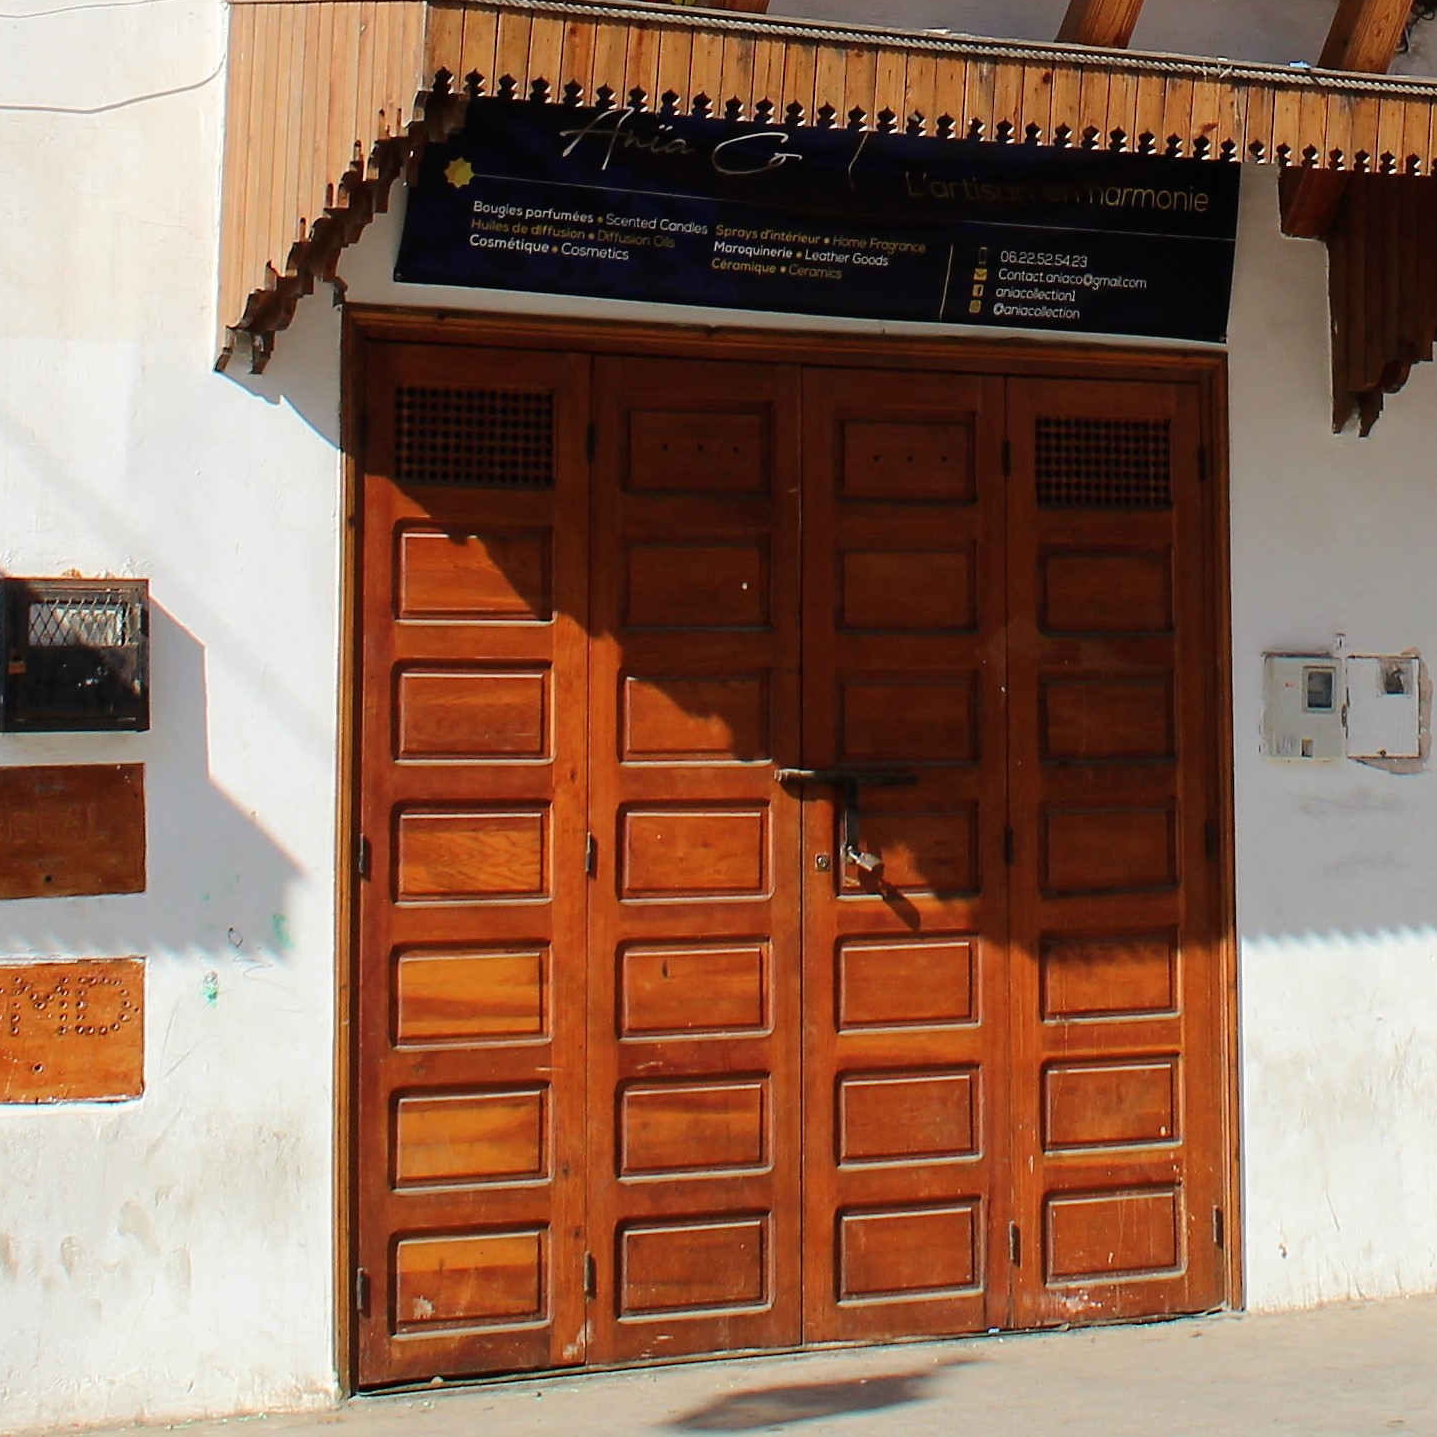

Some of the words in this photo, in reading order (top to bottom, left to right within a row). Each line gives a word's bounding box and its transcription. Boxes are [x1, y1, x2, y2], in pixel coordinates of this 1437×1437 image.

[903, 170, 1033, 203] L'artisan
[1088, 182, 1210, 212] harmonie
[472, 200, 523, 219] Bougies
[524, 207, 594, 224] parfumées
[605, 213, 658, 230] Scented
[659, 219, 709, 235] Candles
[469, 233, 550, 254] Cosmétique
[561, 241, 631, 261] Cosmetics
[470, 217, 510, 233] Huiles
[512, 223, 529, 234] de
[530, 223, 586, 240] diffusion
[596, 229, 651, 246] Diffusion
[653, 234, 676, 248] Oils
[715, 224, 758, 241] Sprays
[760, 228, 821, 244] d'intérieur
[833, 234, 867, 249] Home
[868, 237, 927, 256] Fragrance
[713, 240, 794, 258] Maroquinerie
[804, 248, 850, 263] Leather
[852, 252, 890, 267] Goods
[711, 257, 777, 275] Céramique
[787, 263, 843, 280] Ceramics
[992, 302, 1081, 320] @aniacollection
